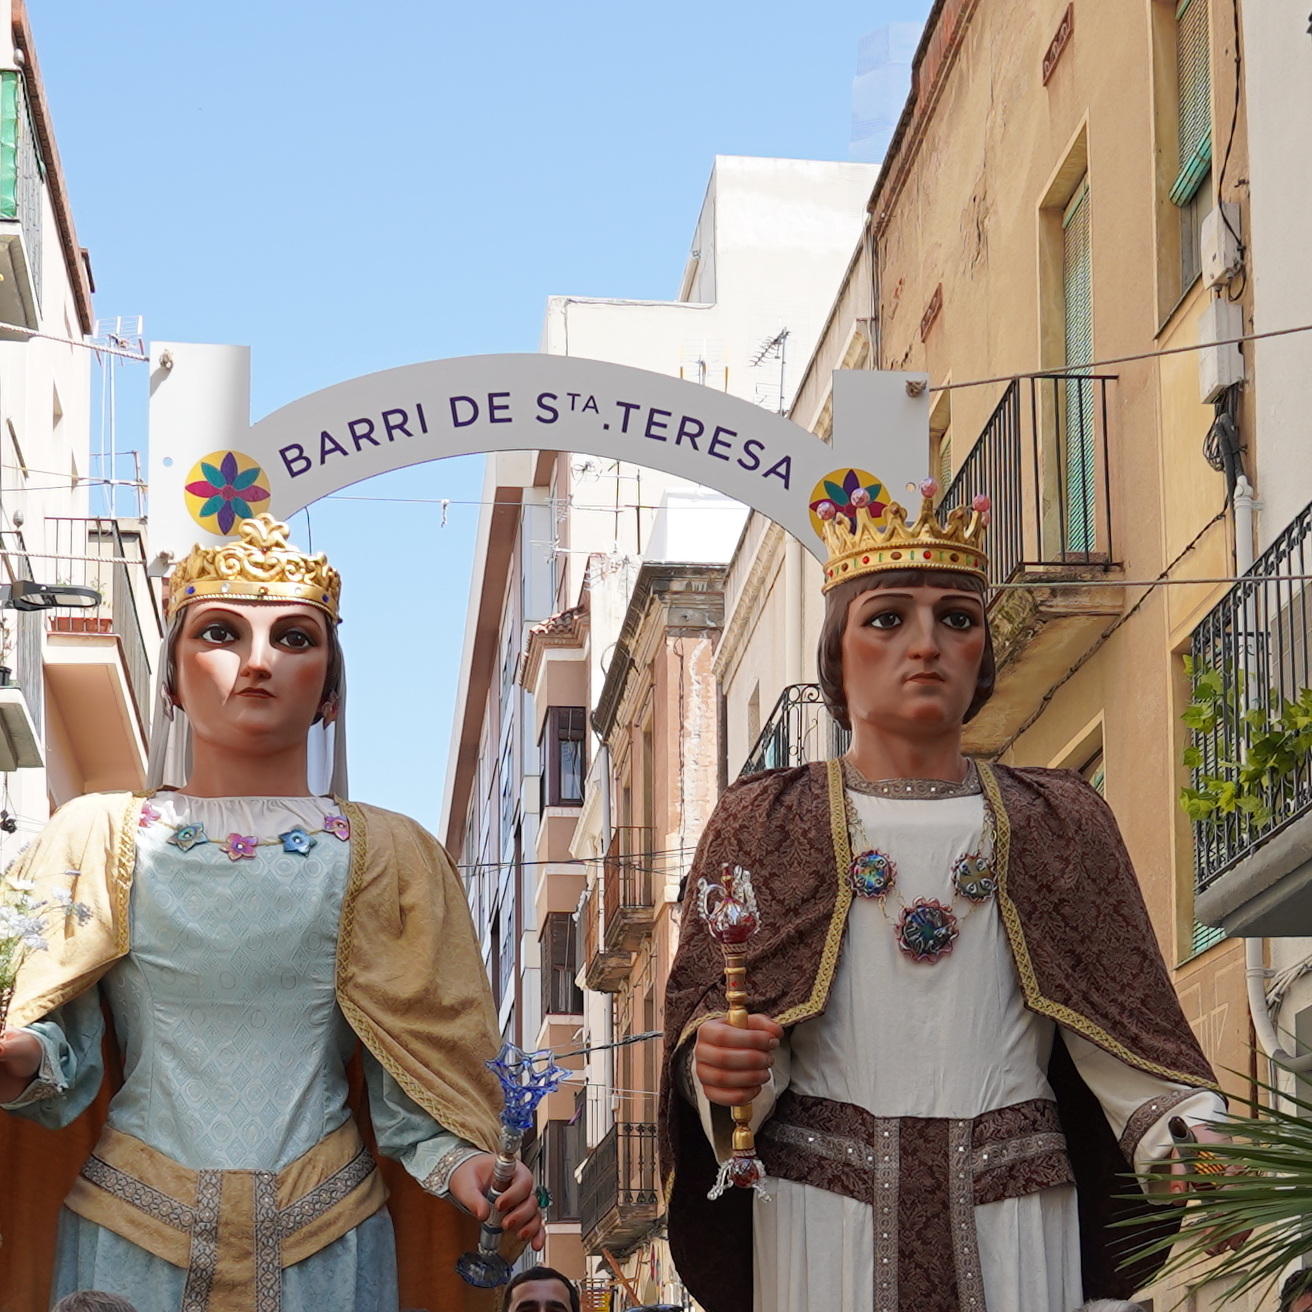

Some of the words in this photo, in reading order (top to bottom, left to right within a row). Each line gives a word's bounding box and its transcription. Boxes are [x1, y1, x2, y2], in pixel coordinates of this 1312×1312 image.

[278, 403, 429, 478] BARRI
[449, 391, 513, 428] DE
[615, 401, 793, 491] TERESA
